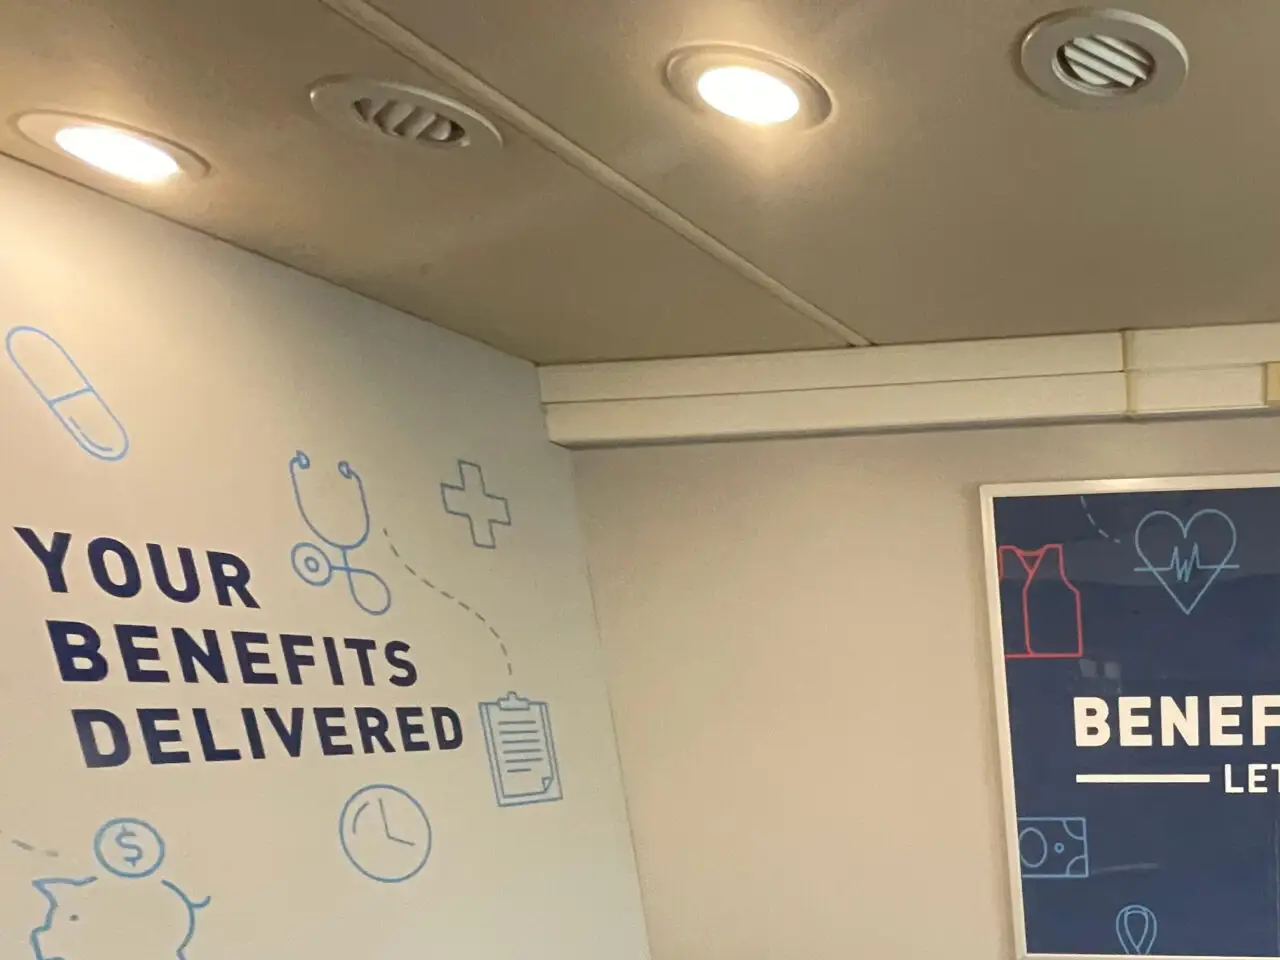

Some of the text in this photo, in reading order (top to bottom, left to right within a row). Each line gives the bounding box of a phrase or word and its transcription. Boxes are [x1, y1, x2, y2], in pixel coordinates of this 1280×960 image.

[13, 526, 260, 609] YOUR
[45, 619, 418, 687] BENEFITS
[70, 705, 464, 769] DELIVERED
